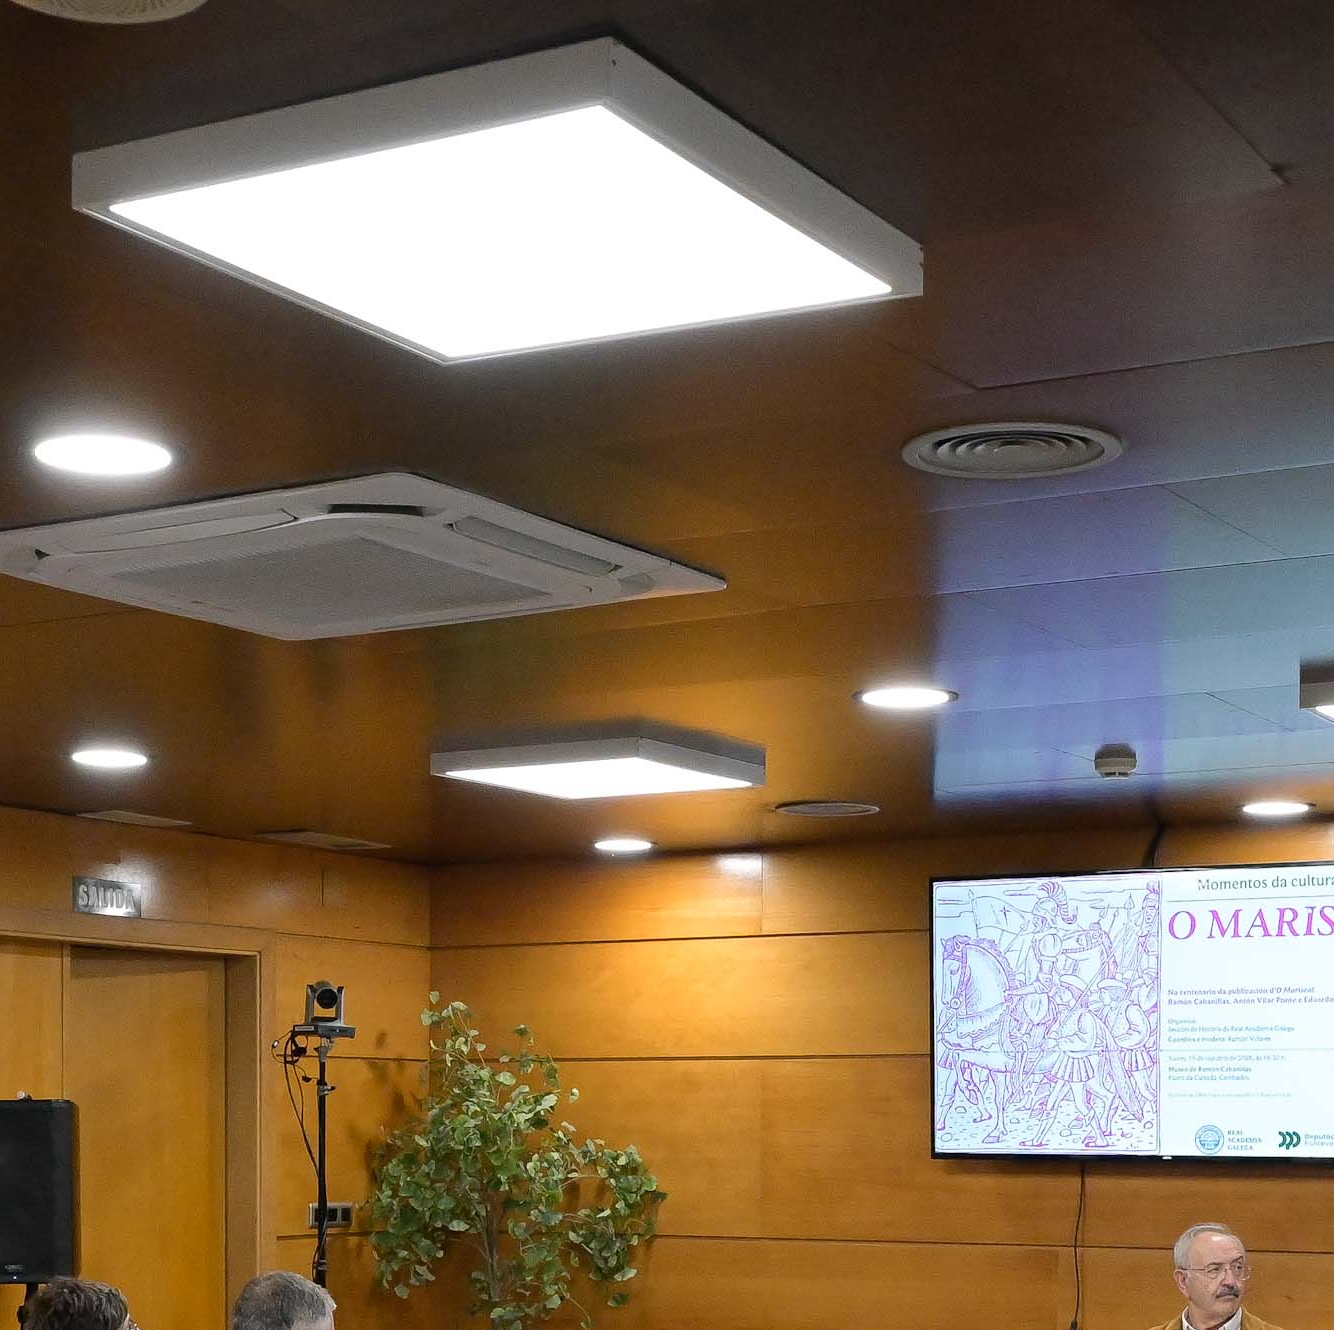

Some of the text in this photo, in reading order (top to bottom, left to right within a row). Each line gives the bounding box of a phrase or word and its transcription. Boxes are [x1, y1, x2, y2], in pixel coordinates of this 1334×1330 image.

[1197, 878, 1268, 891] Momentos
[1271, 875, 1288, 888] da
[78, 884, 136, 913] SALIDA
[1168, 910, 1197, 940] O
